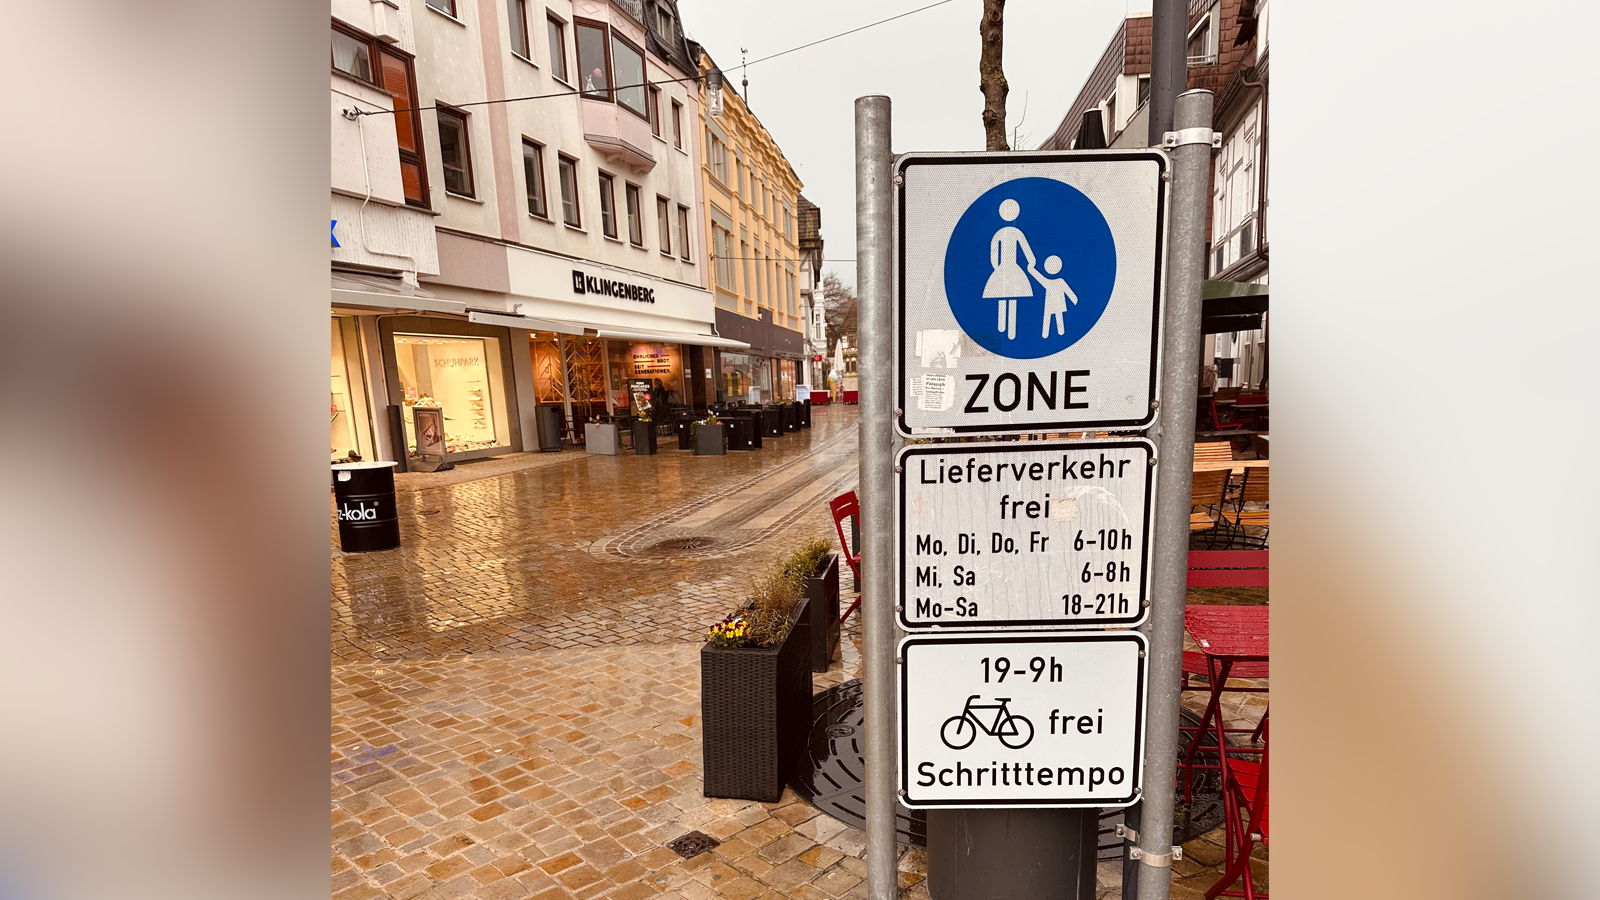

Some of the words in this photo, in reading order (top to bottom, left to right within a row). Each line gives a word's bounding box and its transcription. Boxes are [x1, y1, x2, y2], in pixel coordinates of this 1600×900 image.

[586, 275, 655, 304] KLINGENBERG
[434, 357, 480, 368] SCHUHPARK
[964, 370, 1091, 414] ZONE
[920, 453, 1131, 484] Lieferverkehr
[999, 493, 1050, 520] frei
[916, 534, 948, 557] Mo,
[958, 532, 981, 556] Di,
[991, 532, 1019, 555] Do,
[1029, 531, 1050, 553] Fr
[1073, 529, 1132, 552] 6-10h
[916, 566, 943, 589] Mi,
[953, 565, 976, 587] Sa
[1081, 561, 1130, 584] 6-8h
[916, 596, 978, 619] Mo-Sa
[1061, 592, 1129, 616] 18-21h
[980, 656, 1063, 684] 19-9h
[1048, 708, 1103, 735] frei
[916, 761, 1125, 792] Schritttempo
